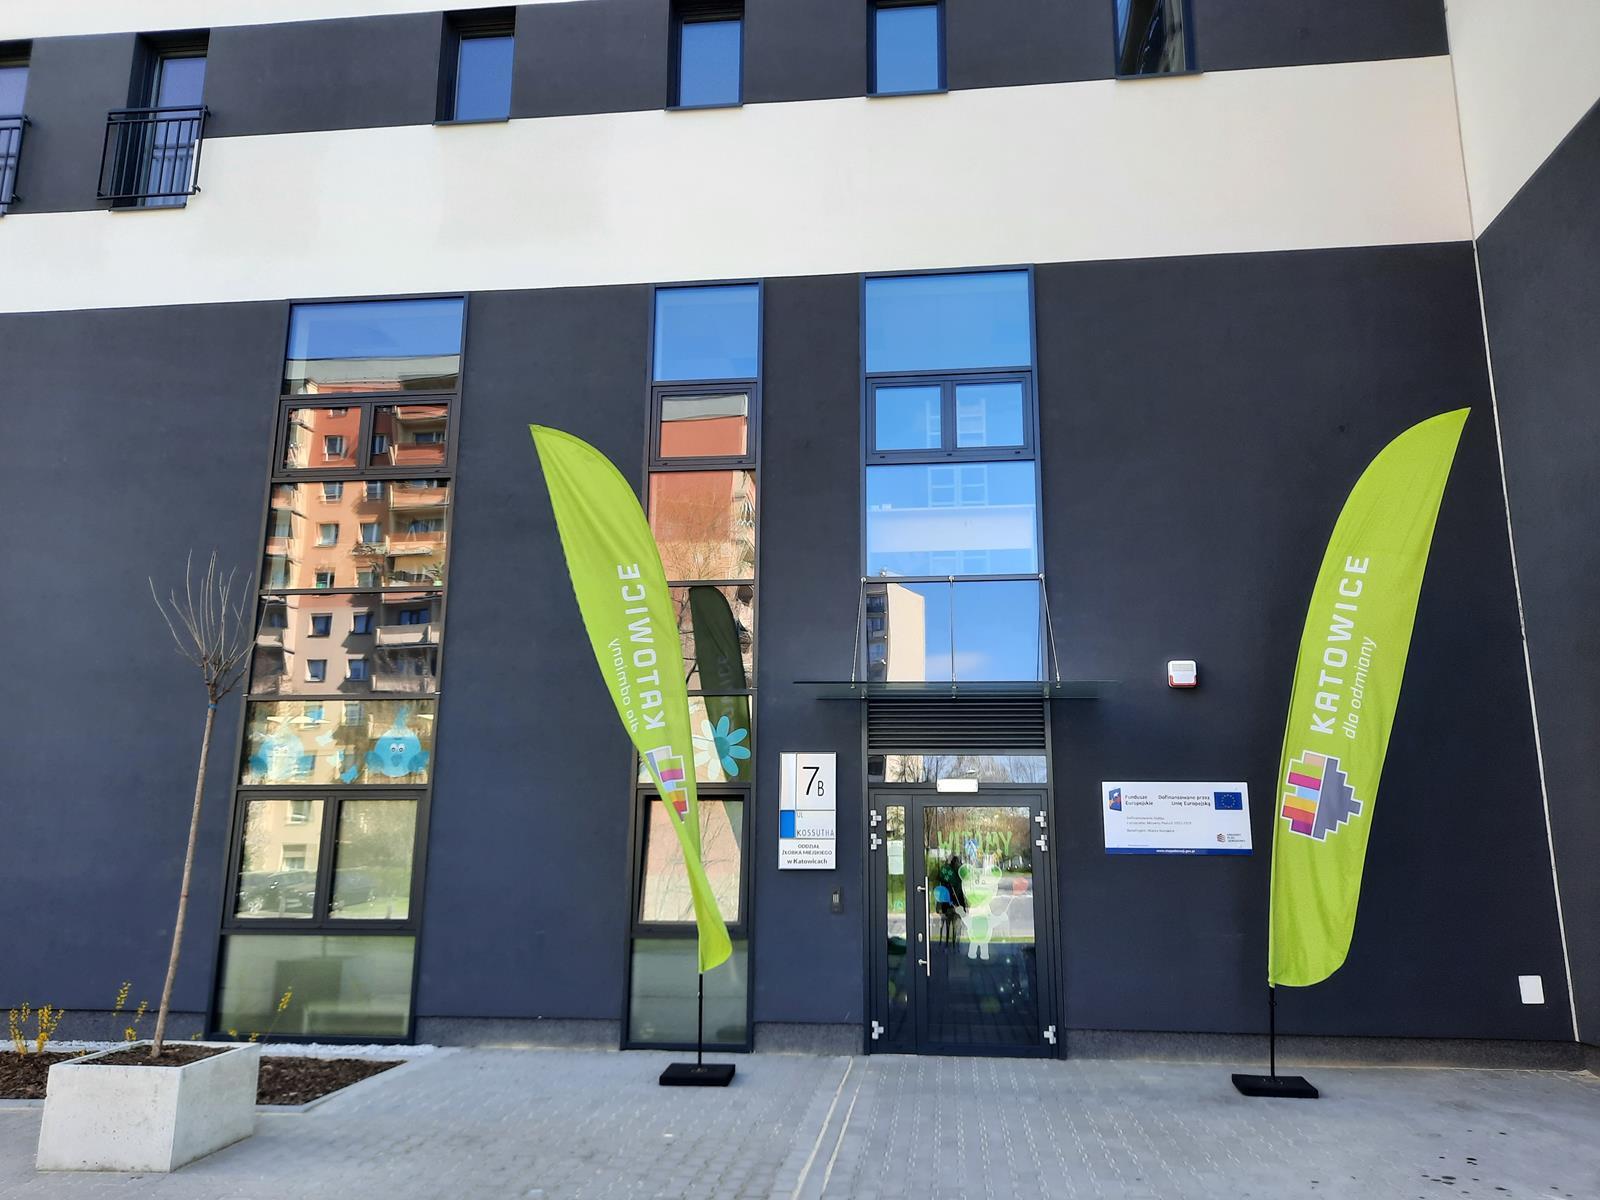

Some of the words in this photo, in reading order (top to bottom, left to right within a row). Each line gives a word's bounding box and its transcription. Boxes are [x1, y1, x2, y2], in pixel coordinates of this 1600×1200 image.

[1310, 556, 1370, 735] KATOWICE
[1350, 636, 1377, 710] odmiany
[1342, 712, 1360, 739] dla
[797, 829, 835, 837] KOSSUTHA
